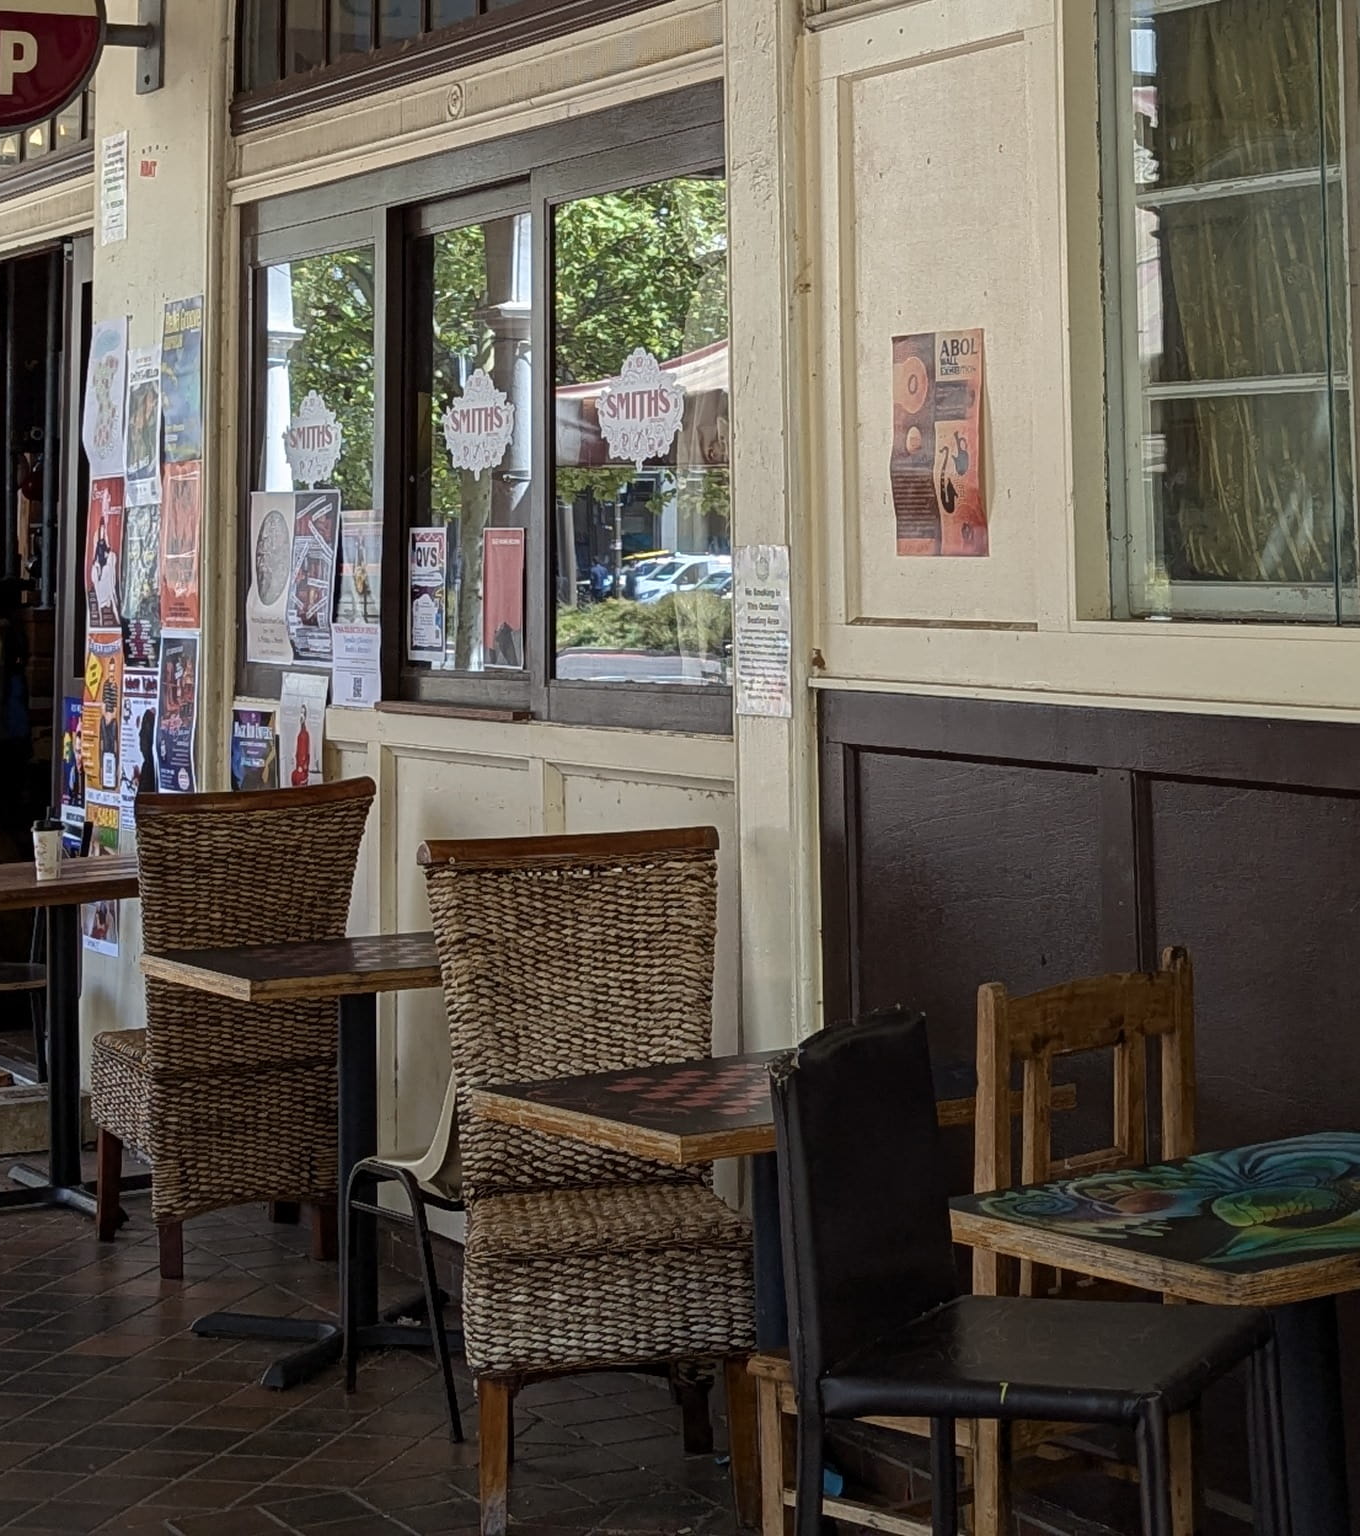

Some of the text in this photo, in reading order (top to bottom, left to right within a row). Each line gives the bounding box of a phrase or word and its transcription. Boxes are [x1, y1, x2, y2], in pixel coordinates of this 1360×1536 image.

[607, 383, 671, 423] SMITH'S
[452, 405, 504, 435] SMITH'S
[289, 424, 333, 452] SMITH'S
[416, 546, 437, 568] QVS
